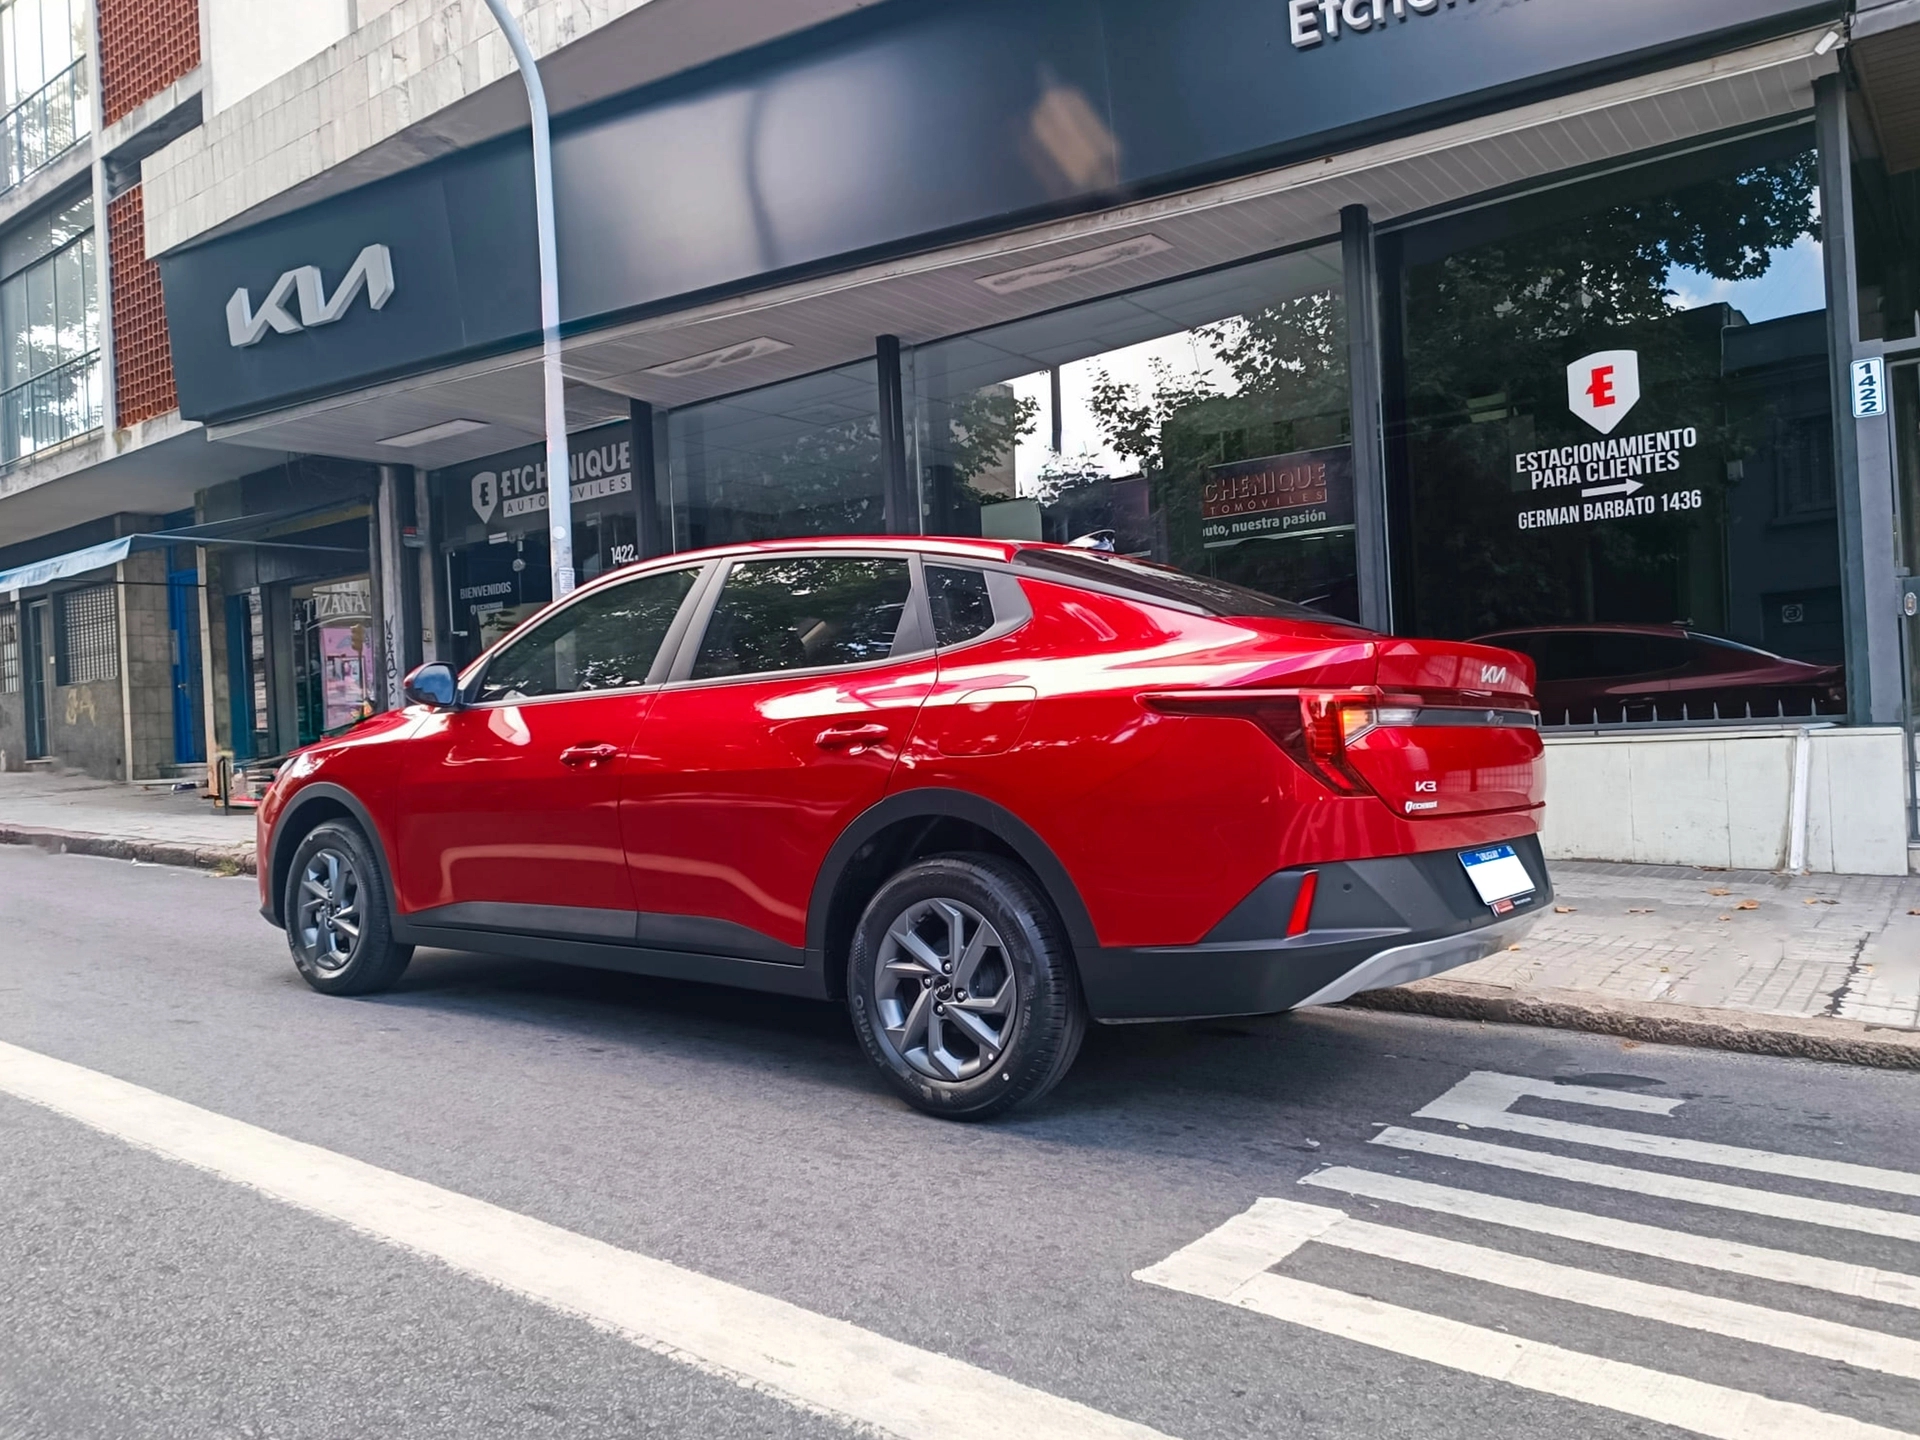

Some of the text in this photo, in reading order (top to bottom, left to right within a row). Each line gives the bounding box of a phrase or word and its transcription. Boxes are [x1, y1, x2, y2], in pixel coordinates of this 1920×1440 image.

[226, 243, 395, 347] KIA
[1858, 362, 1878, 414] 1422
[501, 441, 631, 497] ETCHNIQUE
[1515, 427, 1697, 473] ESTACIONAMIENTO
[1531, 450, 1680, 490] PARA CLIENTES
[506, 476, 628, 514] AUTOVILES
[1518, 490, 1702, 530] GERMAN BARBATO 1436
[1232, 517, 1280, 533] nuestra
[1283, 509, 1327, 529] pasión
[460, 581, 512, 599] BIENVENIDOS
[1481, 664, 1507, 684] KIA
[1415, 780, 1437, 792] K3
